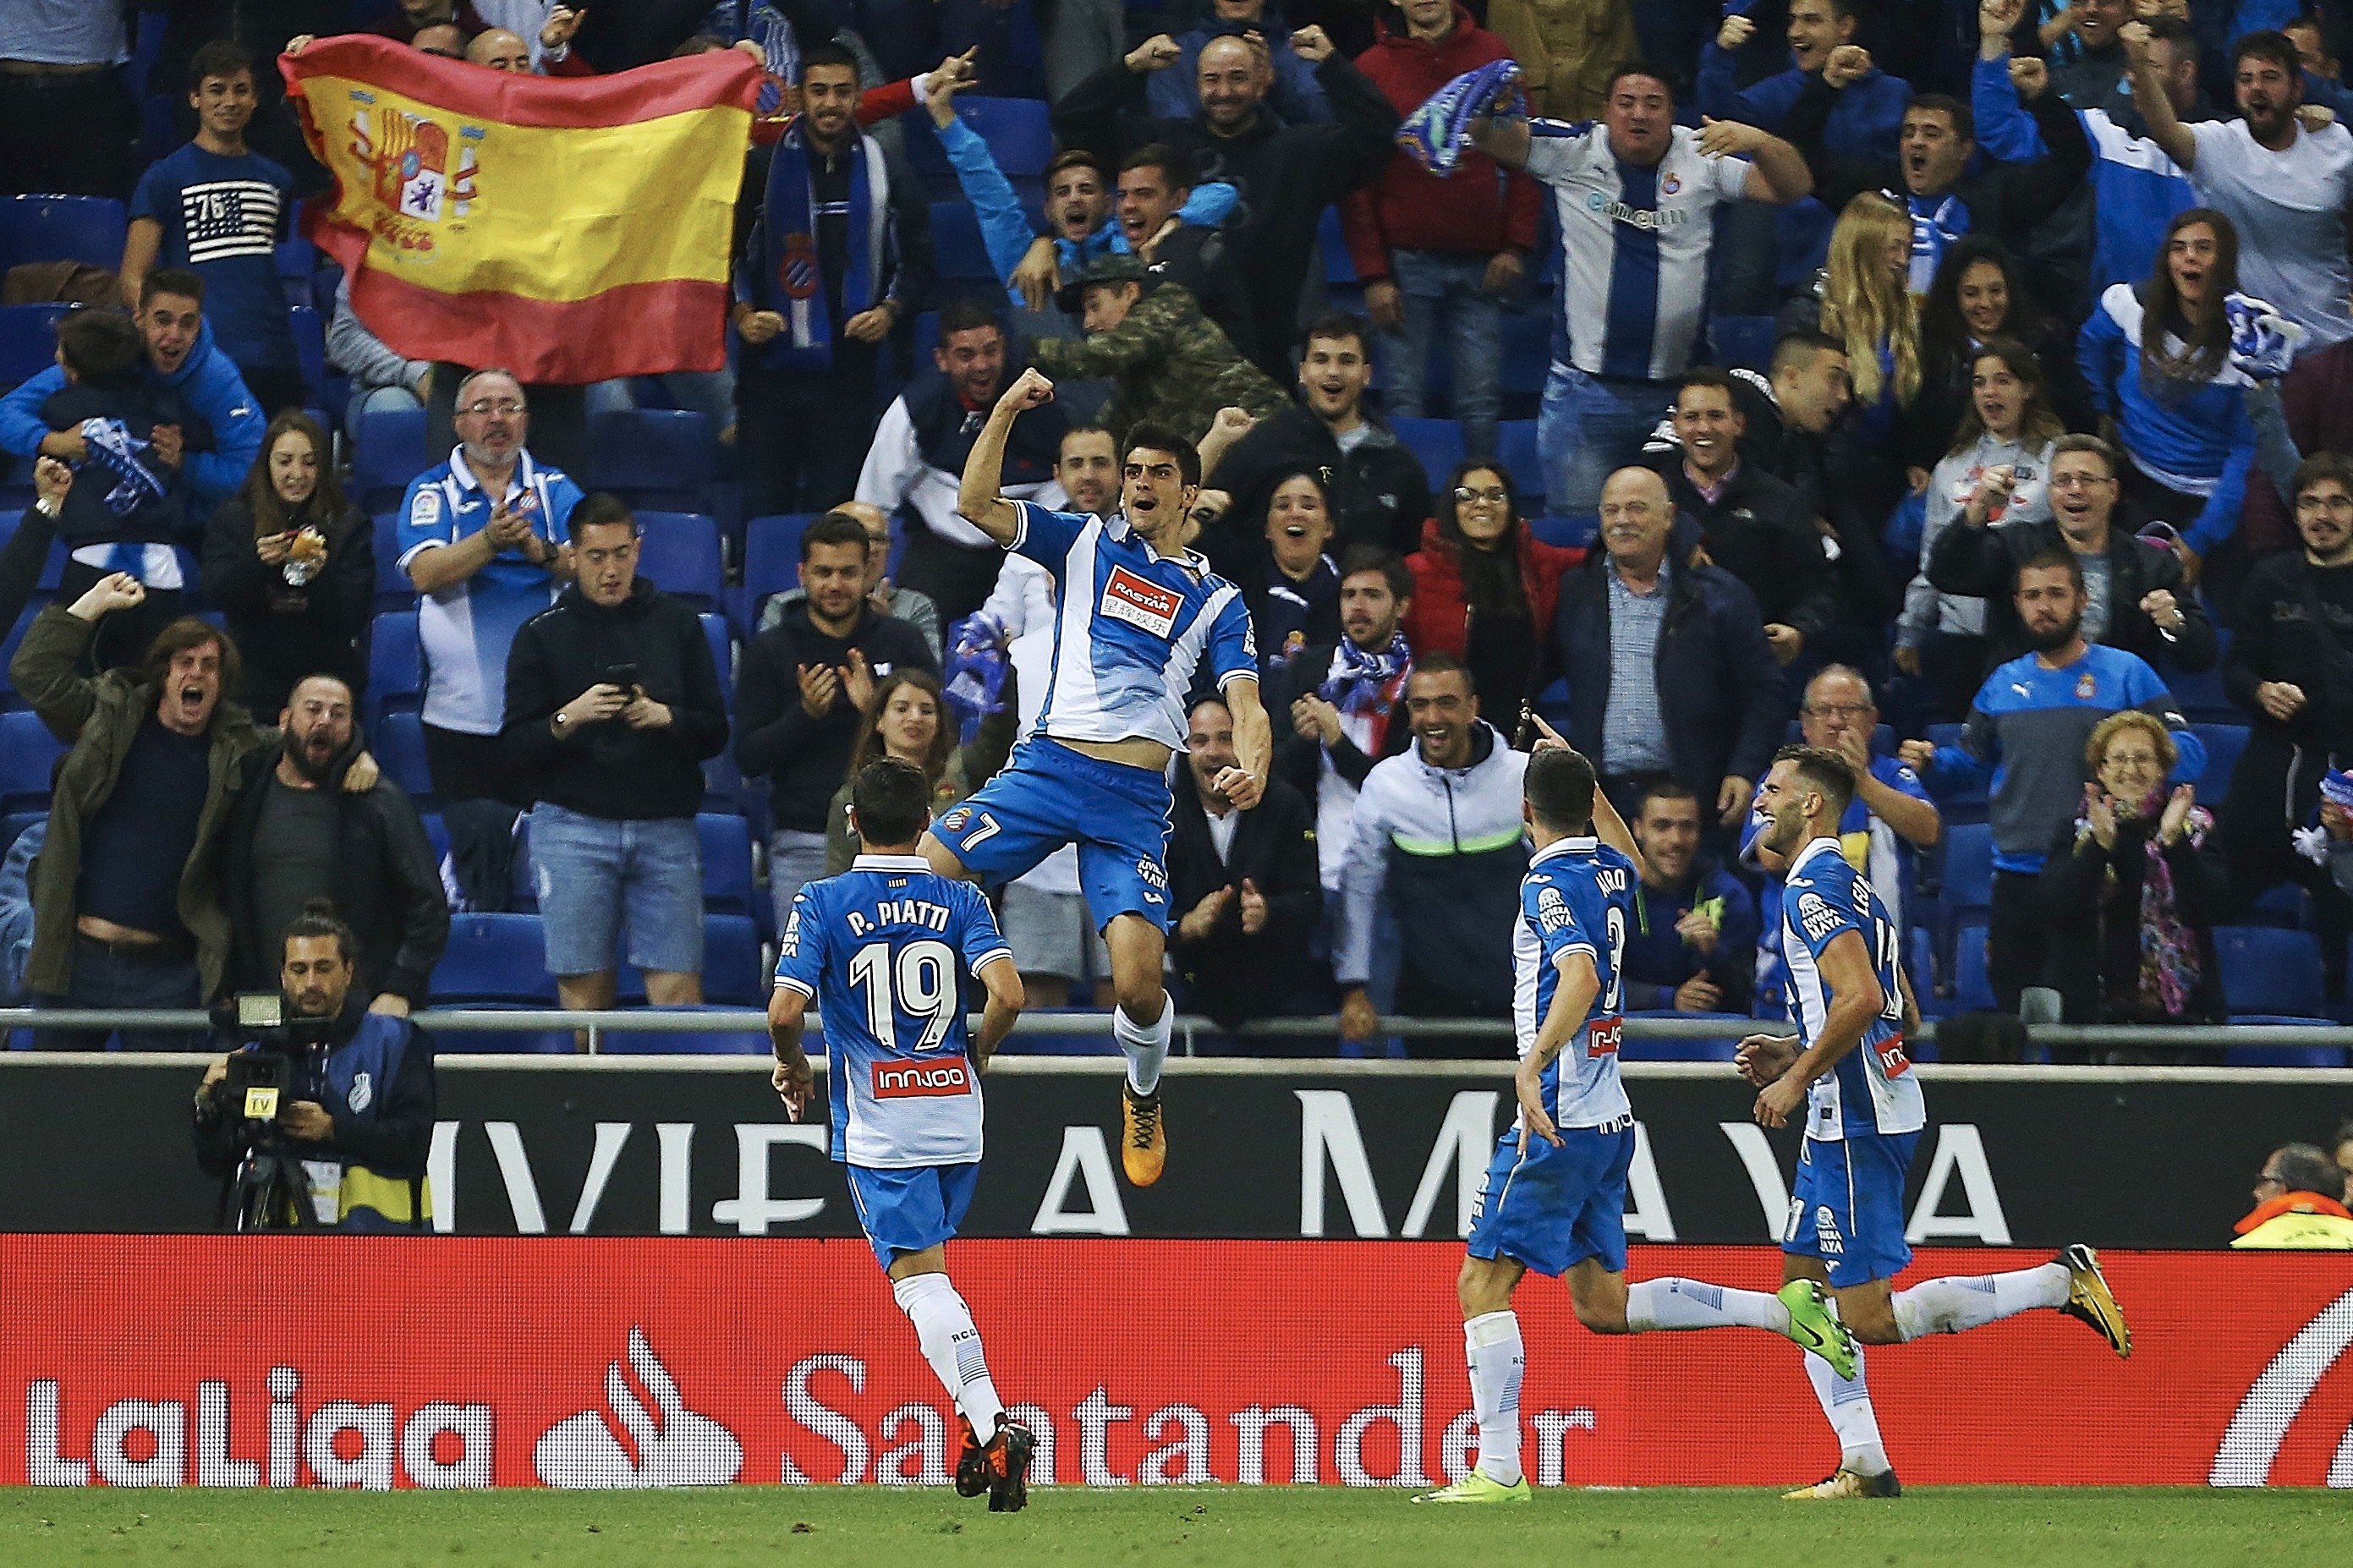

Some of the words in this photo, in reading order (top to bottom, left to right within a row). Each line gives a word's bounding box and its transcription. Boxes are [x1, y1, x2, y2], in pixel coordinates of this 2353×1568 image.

[195, 193, 226, 222] 76
[1115, 581, 1171, 612] RASTAR
[960, 812, 1001, 853] 7
[847, 911, 875, 936] P.
[877, 899, 950, 932] PIATTI
[1542, 914, 1576, 935] MAYA
[1807, 915, 1847, 941] MAYA
[1603, 907, 1626, 1015] 3
[849, 940, 957, 1050] 19
[251, 1098, 269, 1110] TV
[26, 1365, 495, 1490] LaLiga
